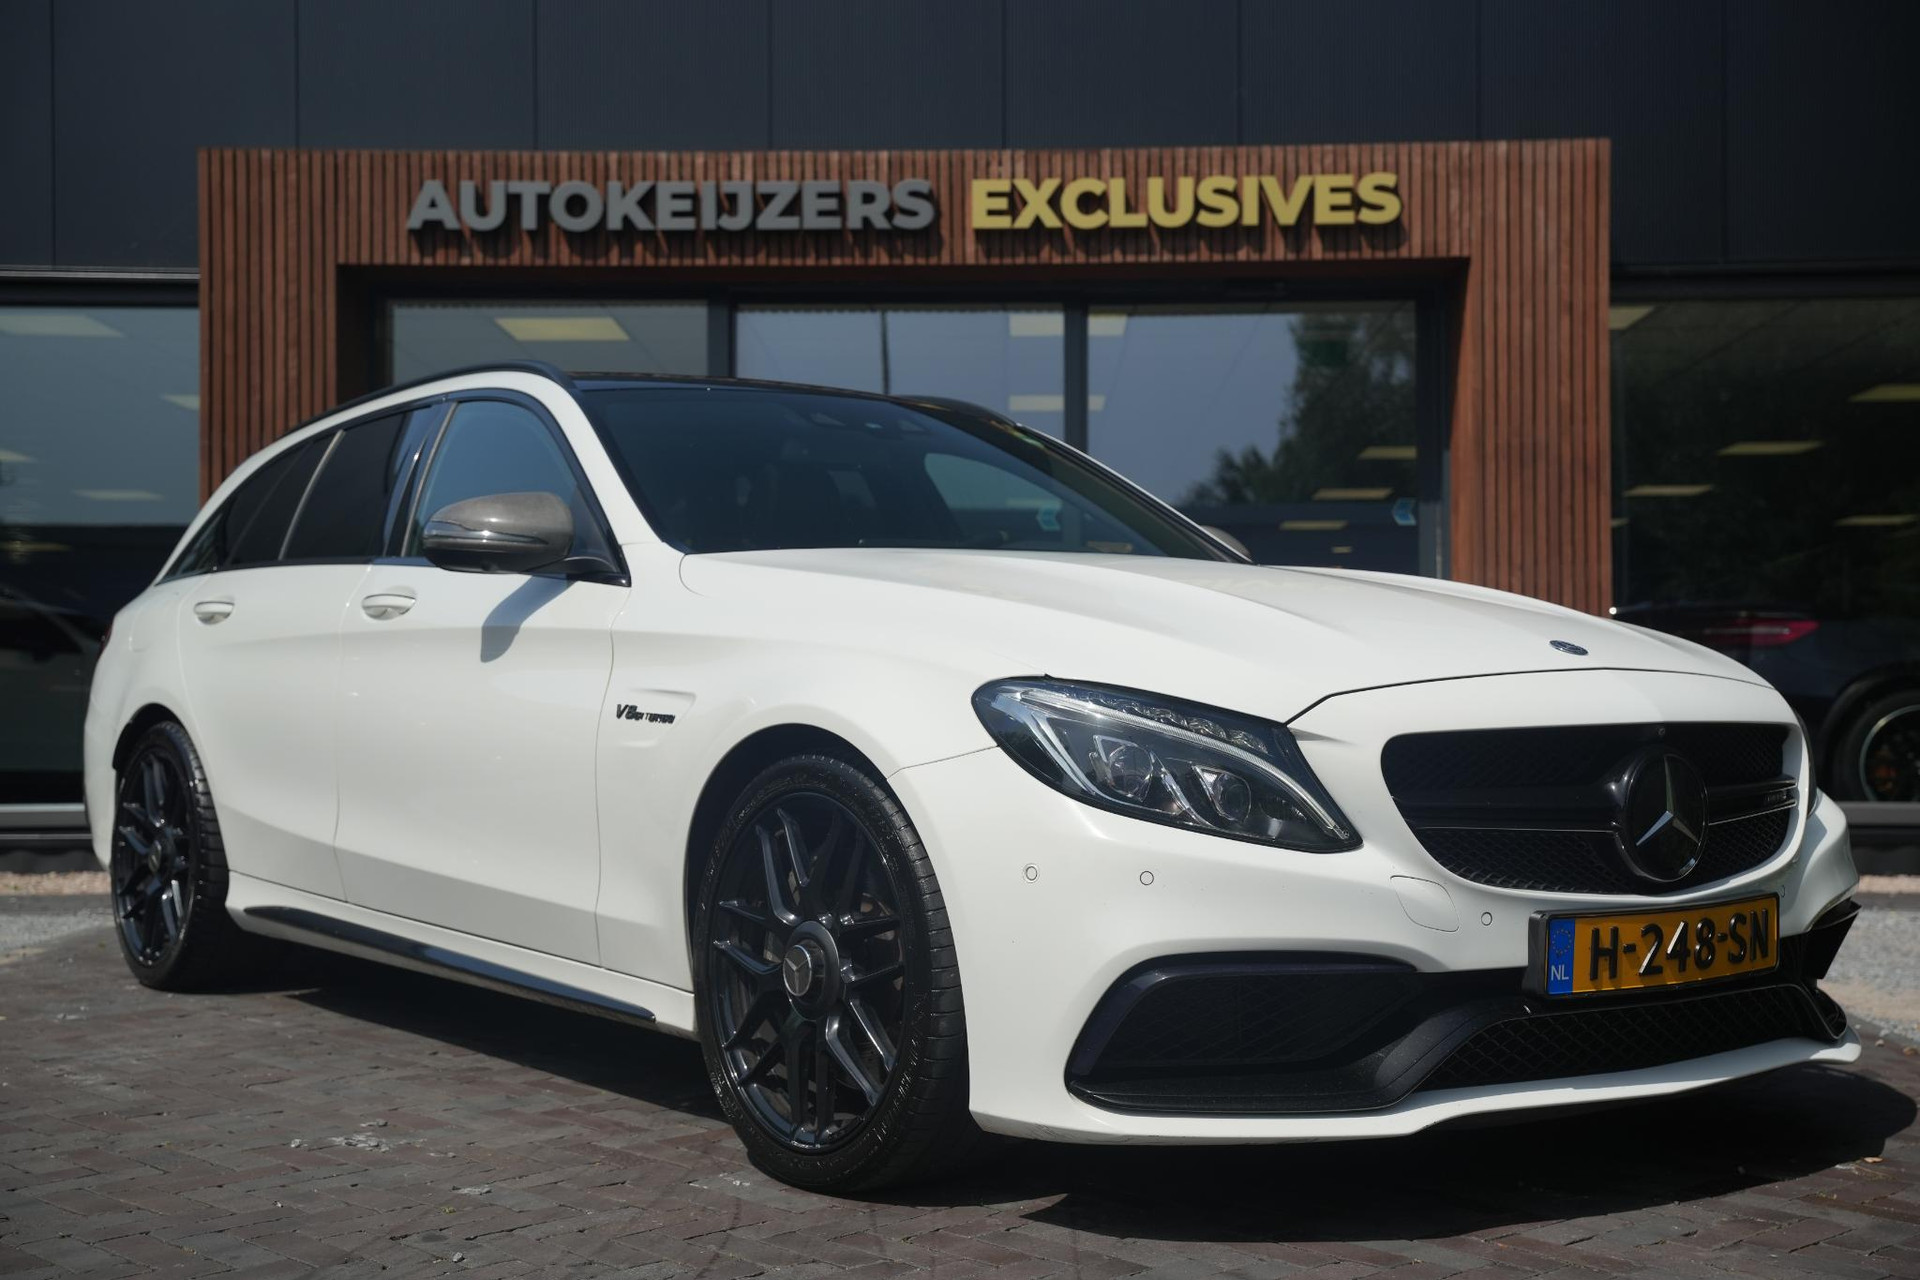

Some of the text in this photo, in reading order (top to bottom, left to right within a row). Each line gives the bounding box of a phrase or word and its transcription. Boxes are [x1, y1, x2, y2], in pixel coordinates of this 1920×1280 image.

[406, 171, 1402, 233] AUTOKEIJZERS EXCLUSIVES
[1550, 964, 1570, 982] NL
[1589, 908, 1769, 981] H-248-SN
